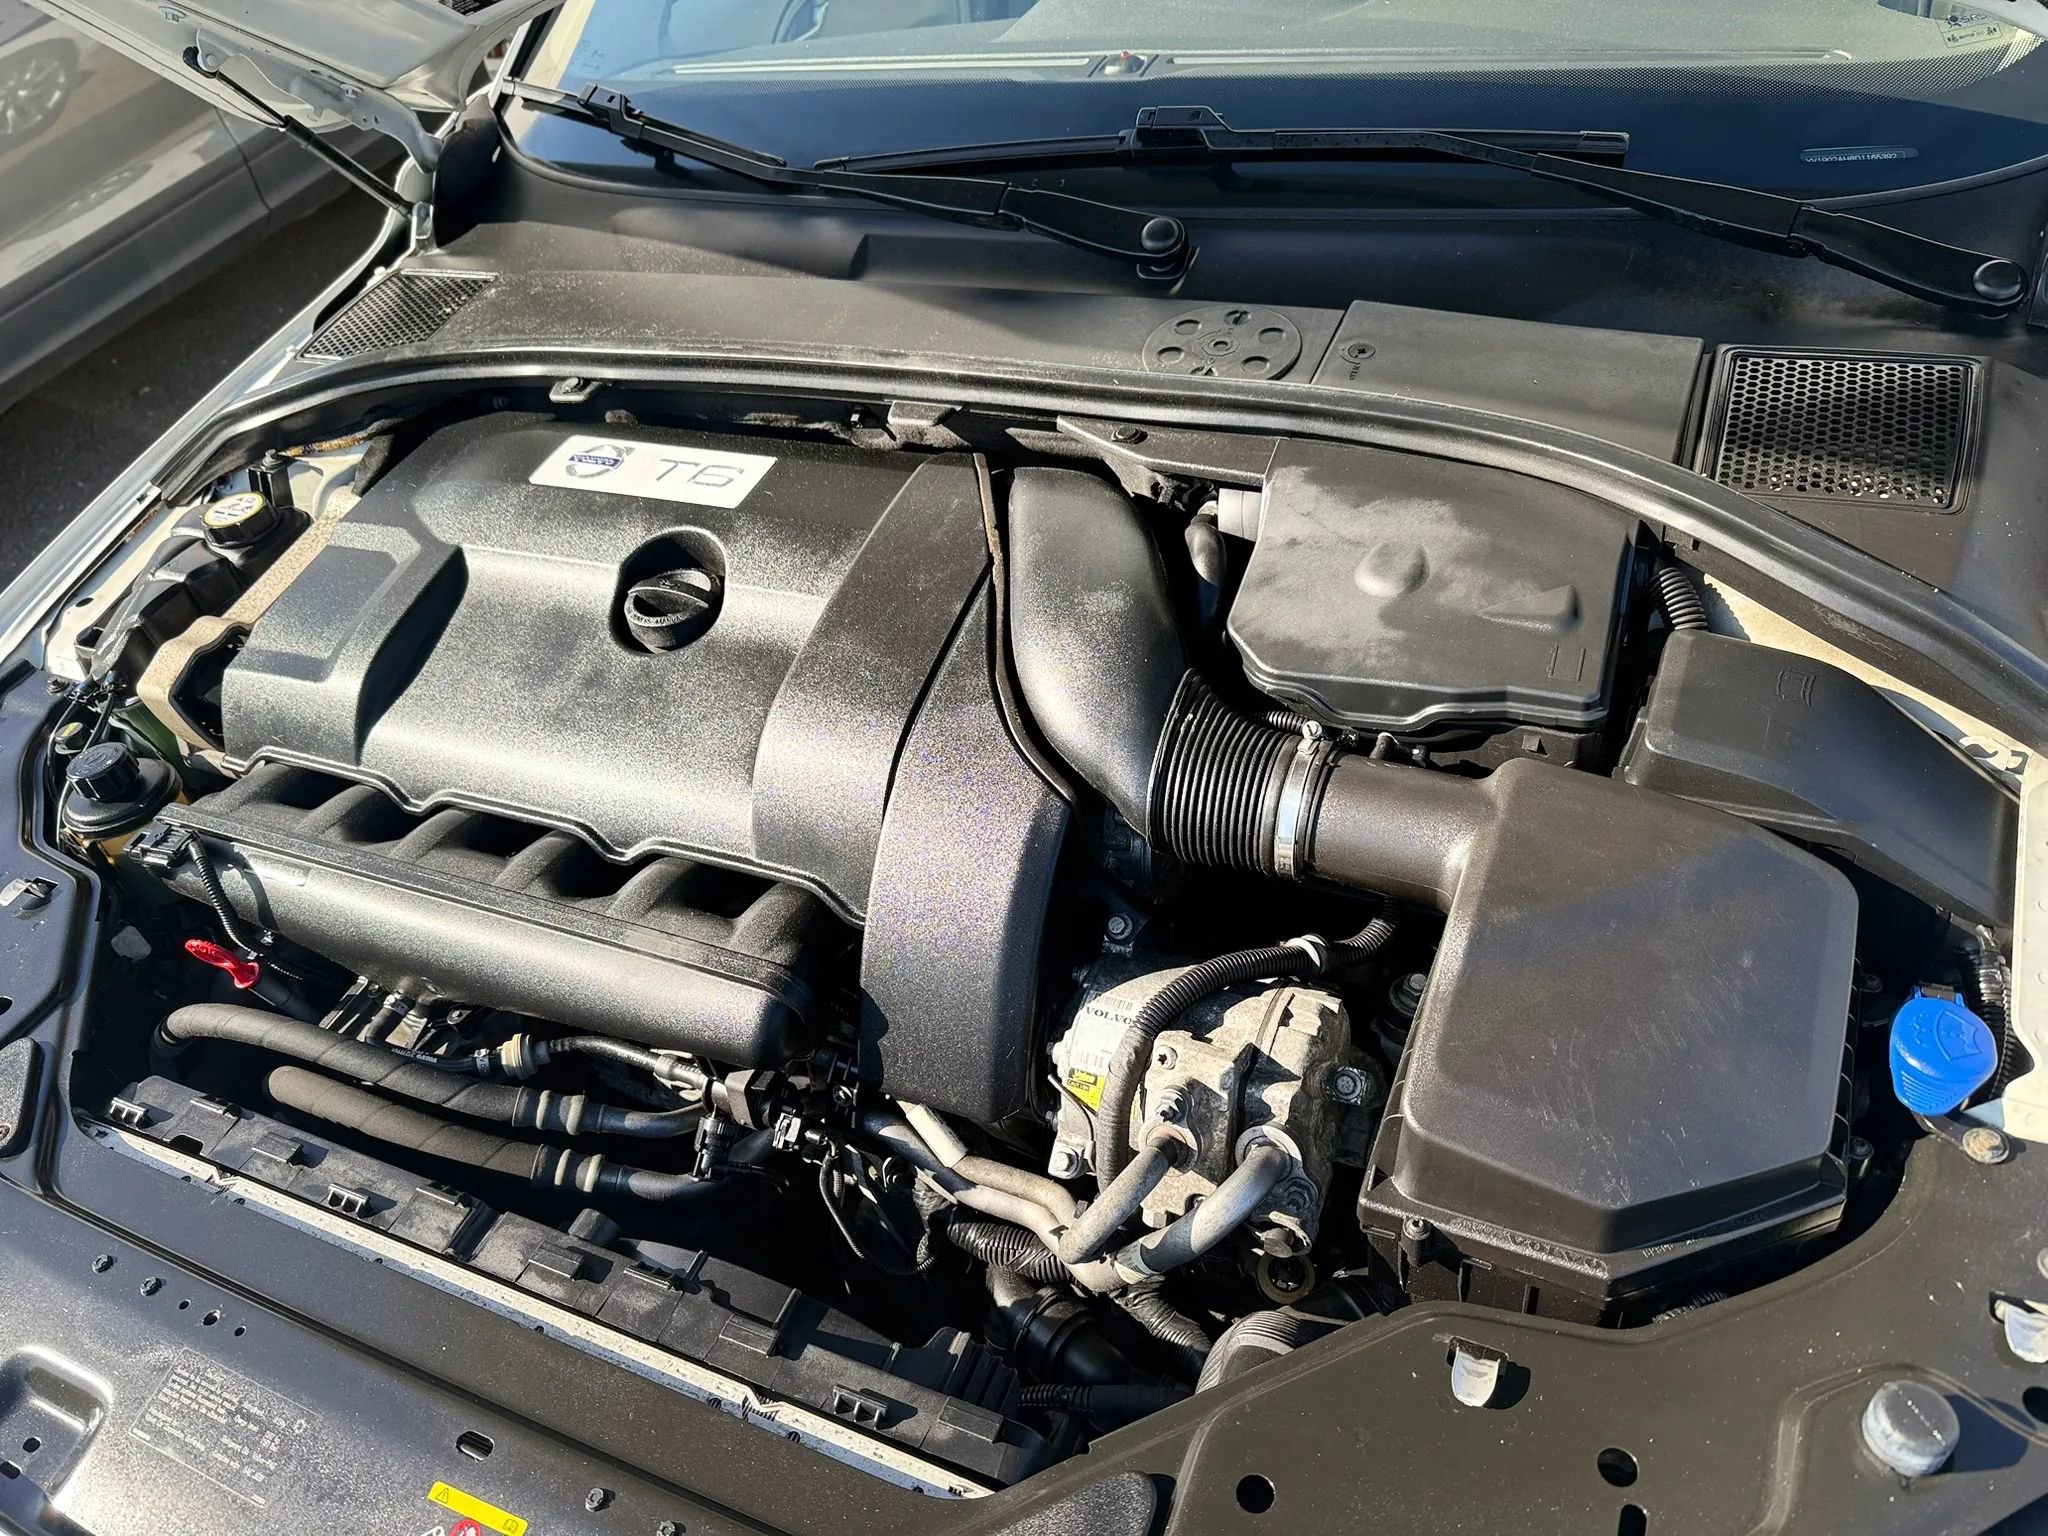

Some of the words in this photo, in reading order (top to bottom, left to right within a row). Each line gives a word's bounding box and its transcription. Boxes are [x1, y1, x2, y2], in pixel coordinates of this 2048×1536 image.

[570, 454, 618, 468] VOLVO
[655, 458, 745, 488] T6
[1086, 1006, 1132, 1025] VOLVO
